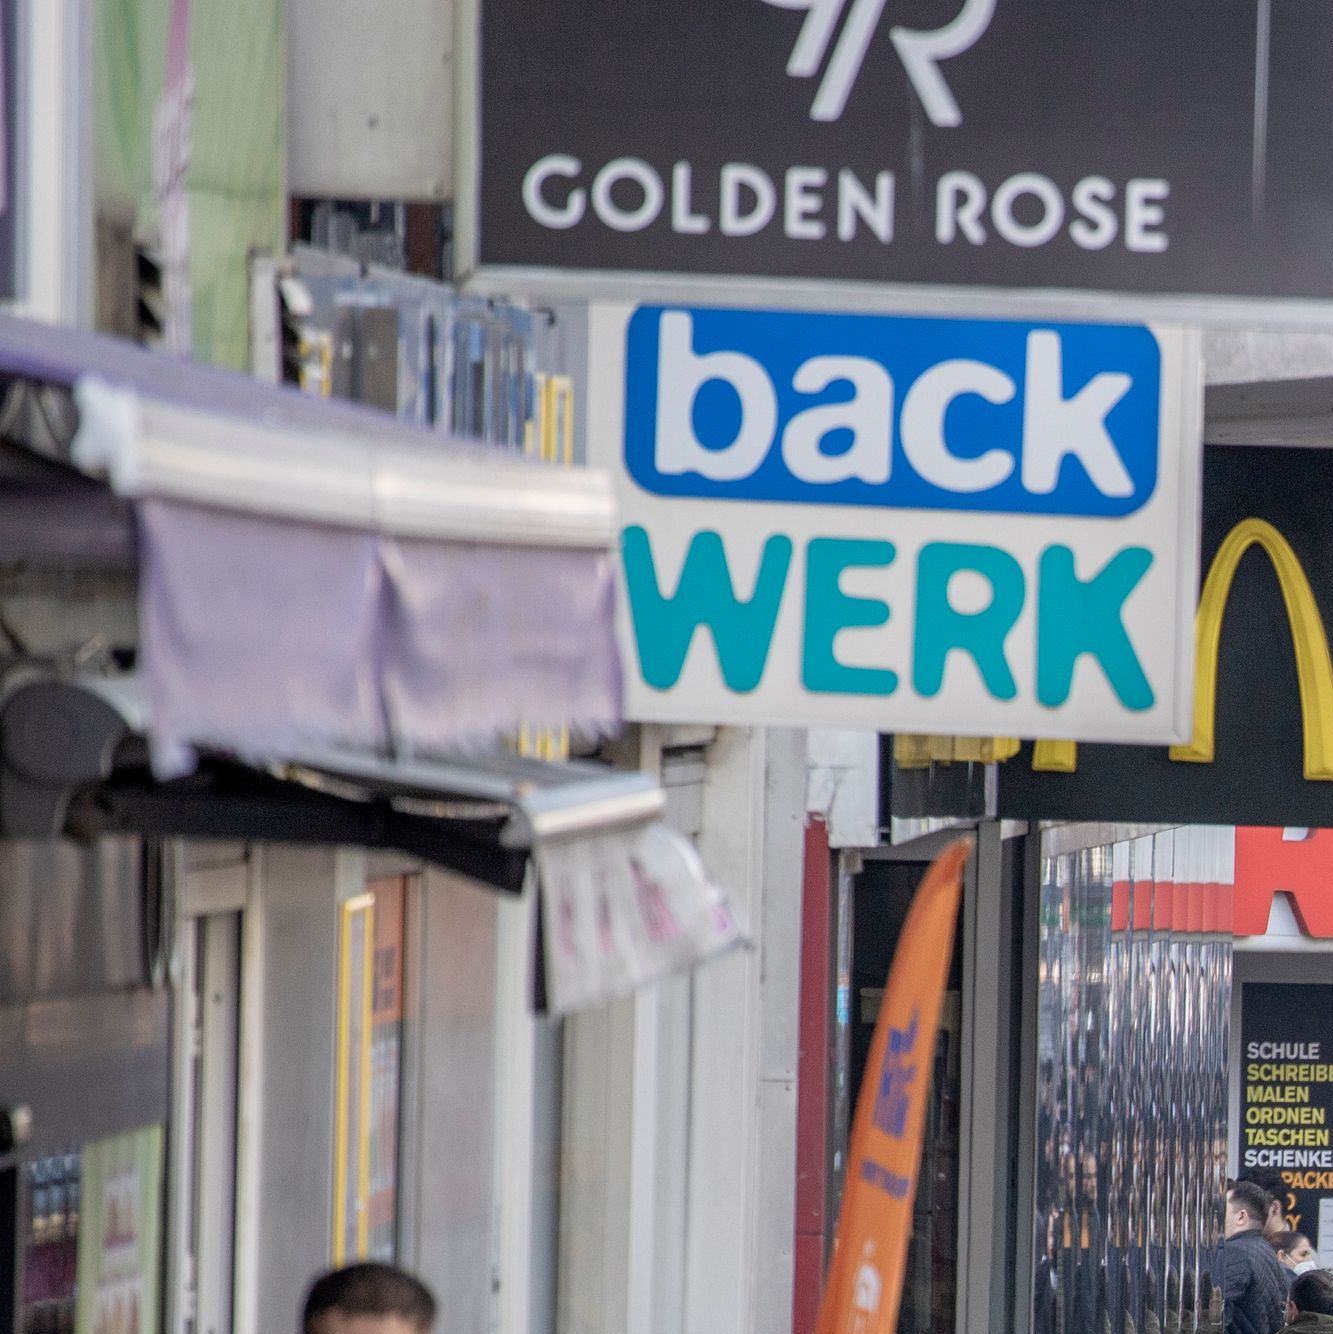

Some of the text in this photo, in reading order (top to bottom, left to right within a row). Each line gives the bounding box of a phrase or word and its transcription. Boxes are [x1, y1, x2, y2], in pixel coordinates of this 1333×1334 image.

[522, 154, 1169, 254] GOLDEN ROSE
[655, 310, 1136, 499] back
[622, 524, 1156, 712] WERK
[1246, 1042, 1320, 1060] SCHULE
[1246, 1085, 1310, 1103] MALEN
[1246, 1106, 1325, 1125] ORDNEN
[1245, 1128, 1330, 1147] TASCHEN
